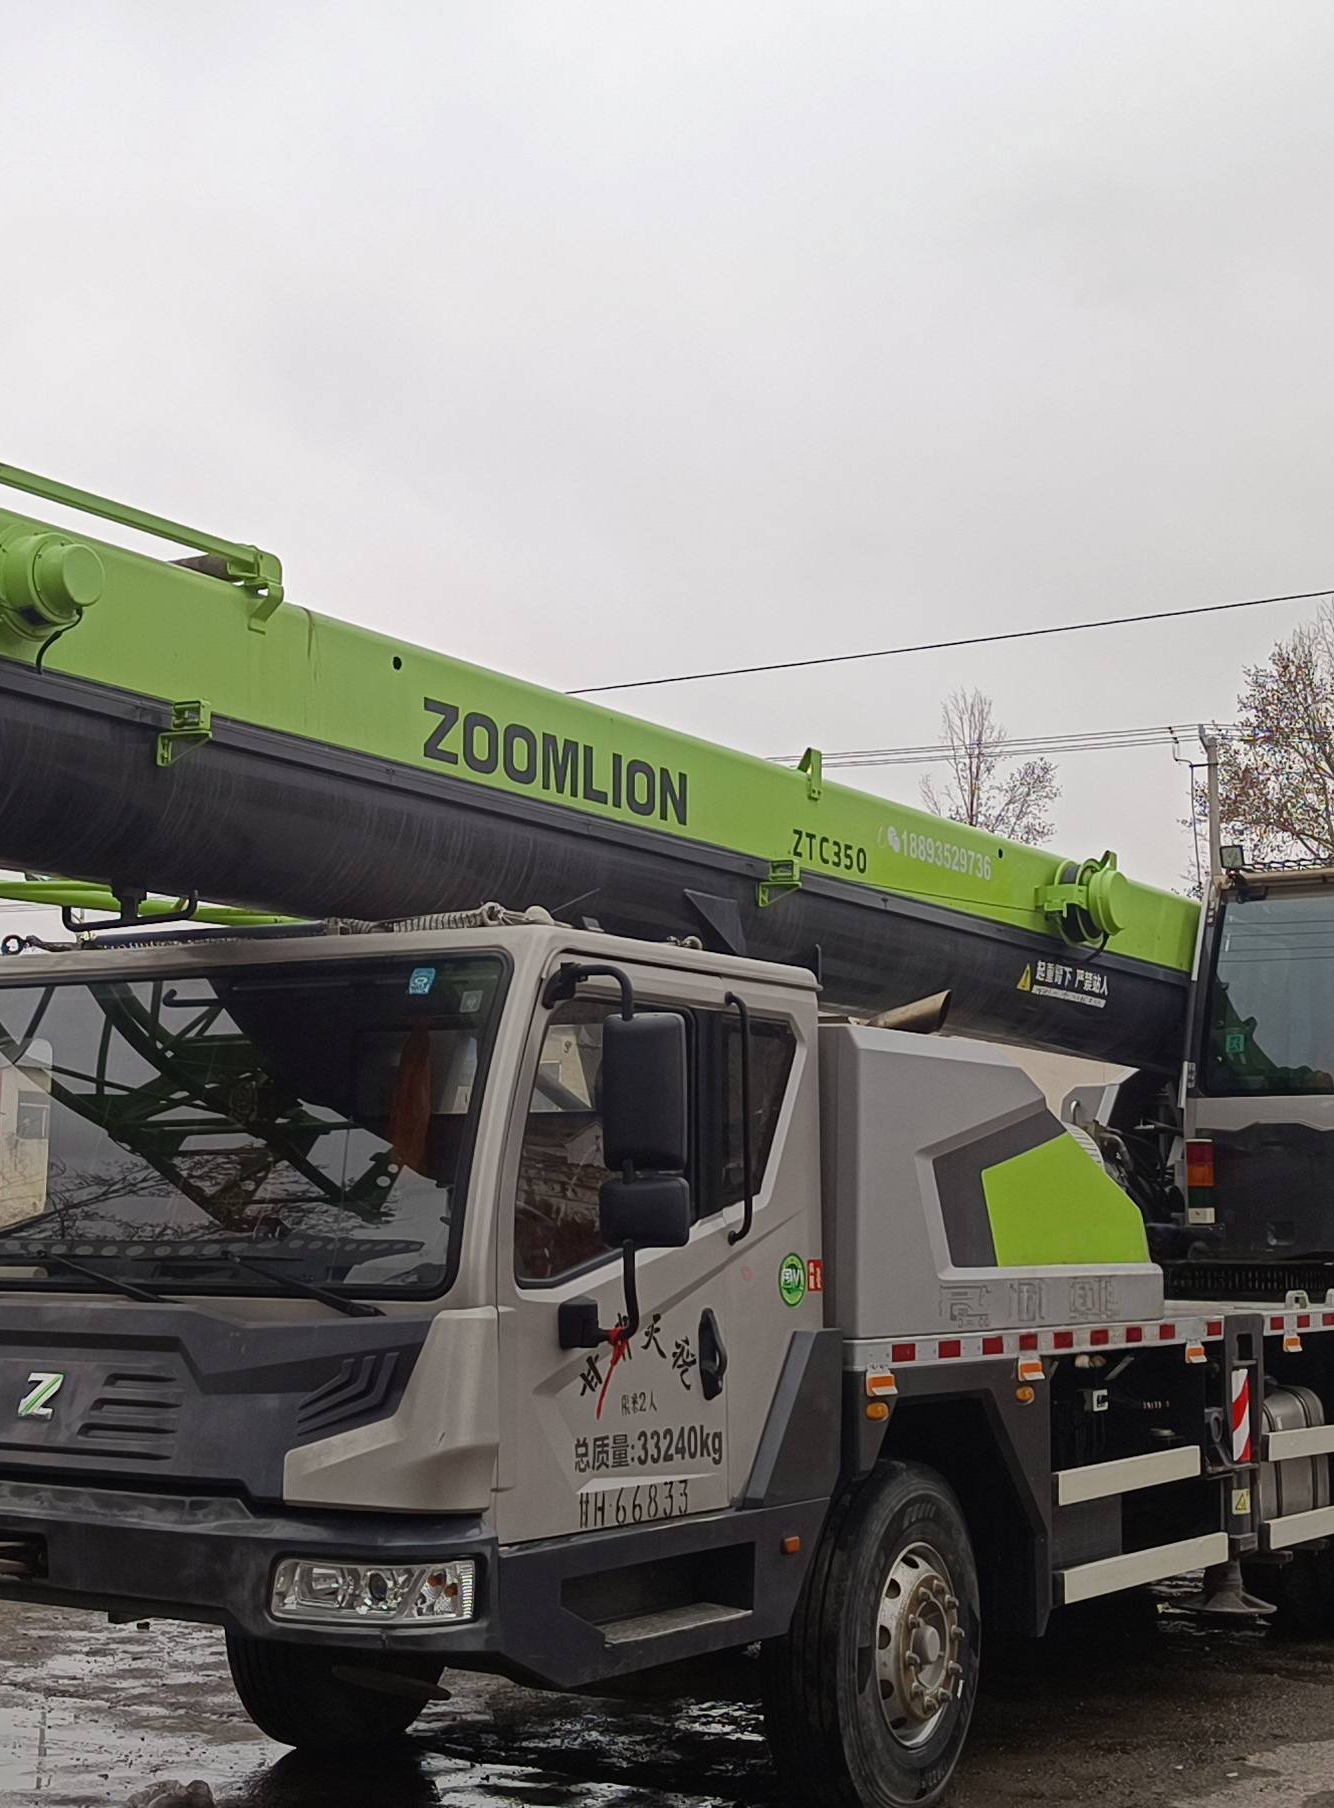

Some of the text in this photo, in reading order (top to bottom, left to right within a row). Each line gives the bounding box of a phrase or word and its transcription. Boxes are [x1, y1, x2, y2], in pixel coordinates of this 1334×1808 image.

[423, 696, 687, 826] ZOOMLION
[792, 829, 867, 874] ZTC350
[900, 830, 992, 880] 18893529736
[18, 1372, 64, 1420] Z
[574, 1424, 723, 1473] 总质量:33240kg
